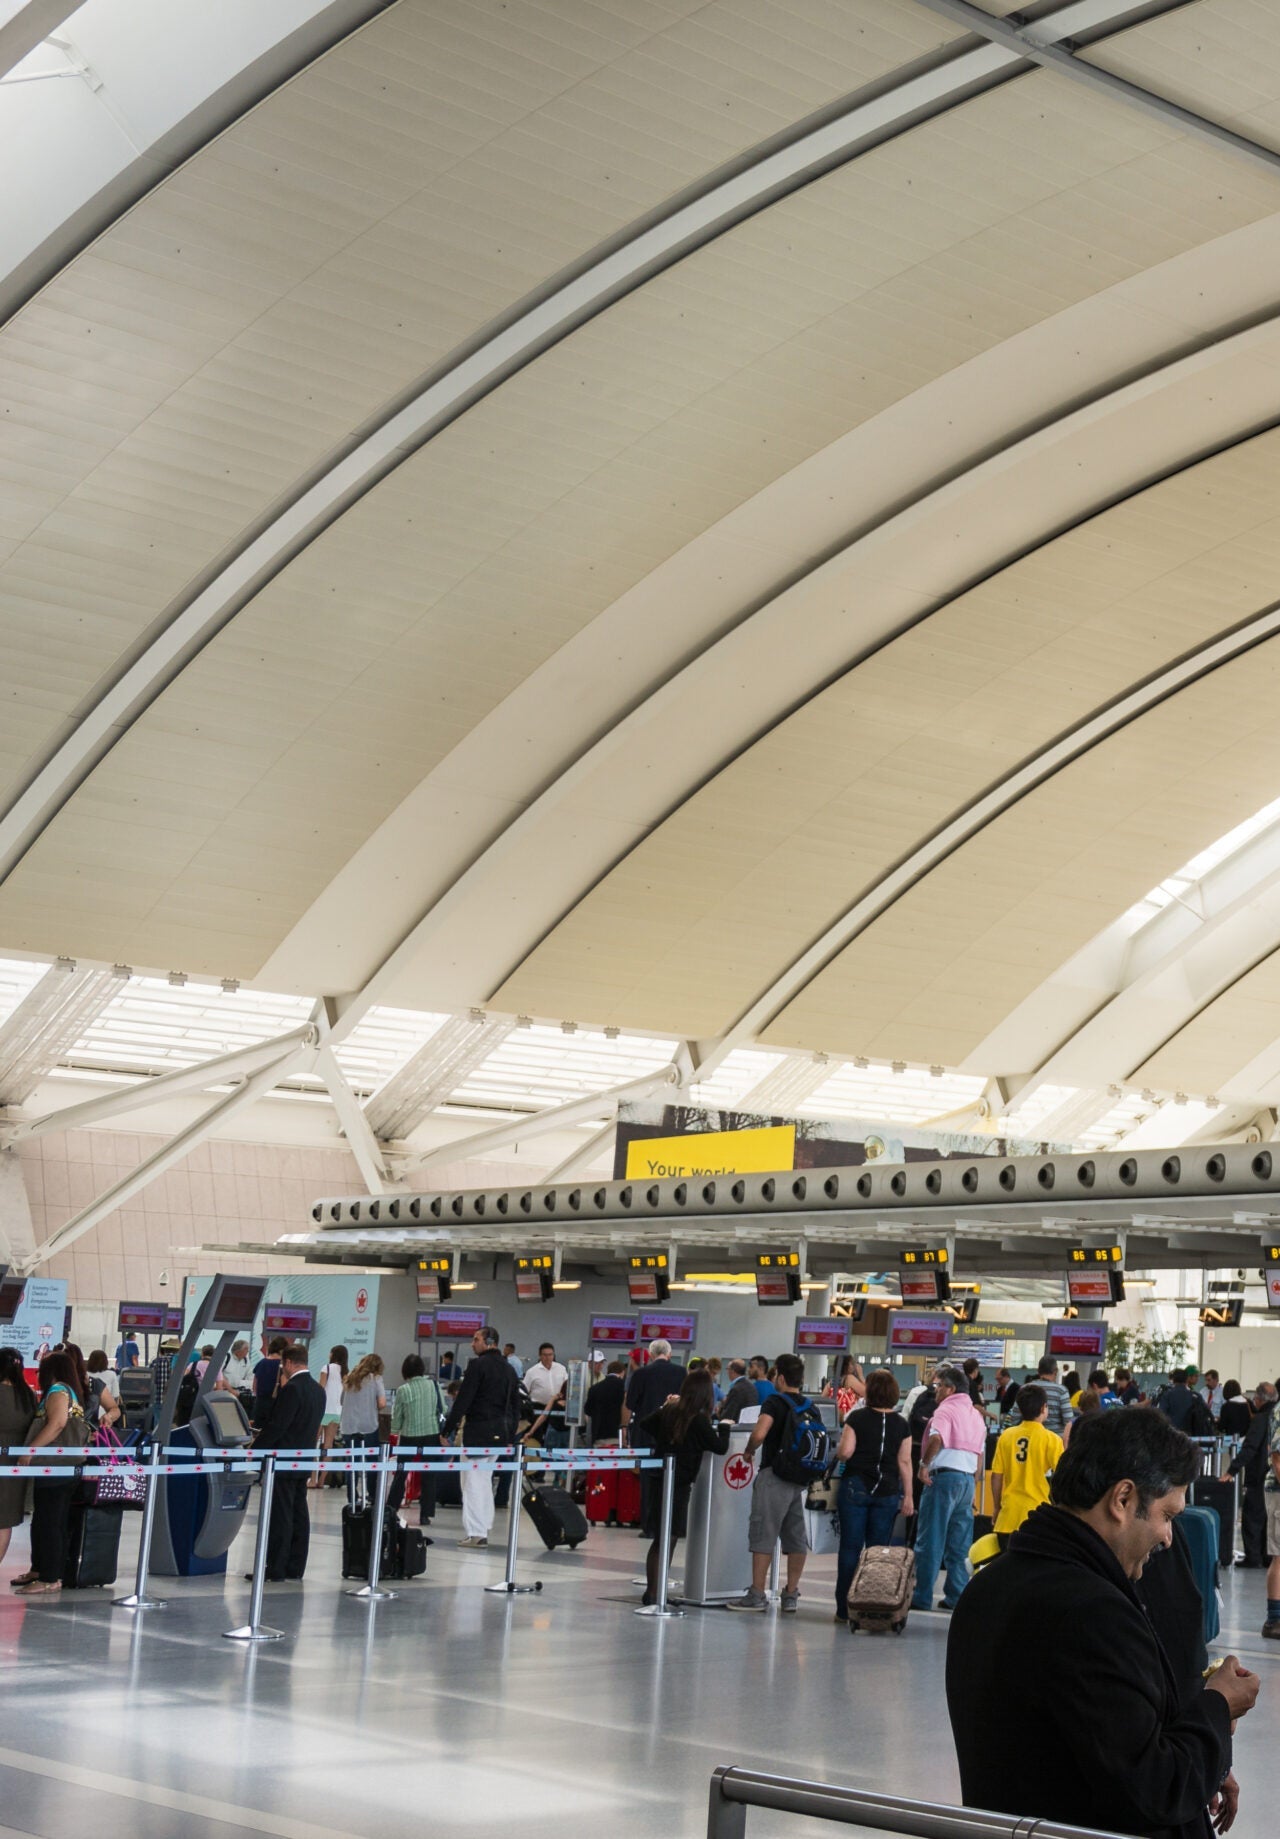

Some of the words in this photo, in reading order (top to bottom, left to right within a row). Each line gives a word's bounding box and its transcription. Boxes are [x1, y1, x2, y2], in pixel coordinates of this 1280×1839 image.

[647, 1160, 685, 1176] Your
[964, 1325, 986, 1335] Gates
[991, 1326, 1015, 1337] Portes
[1015, 1437, 1029, 1463] 3
